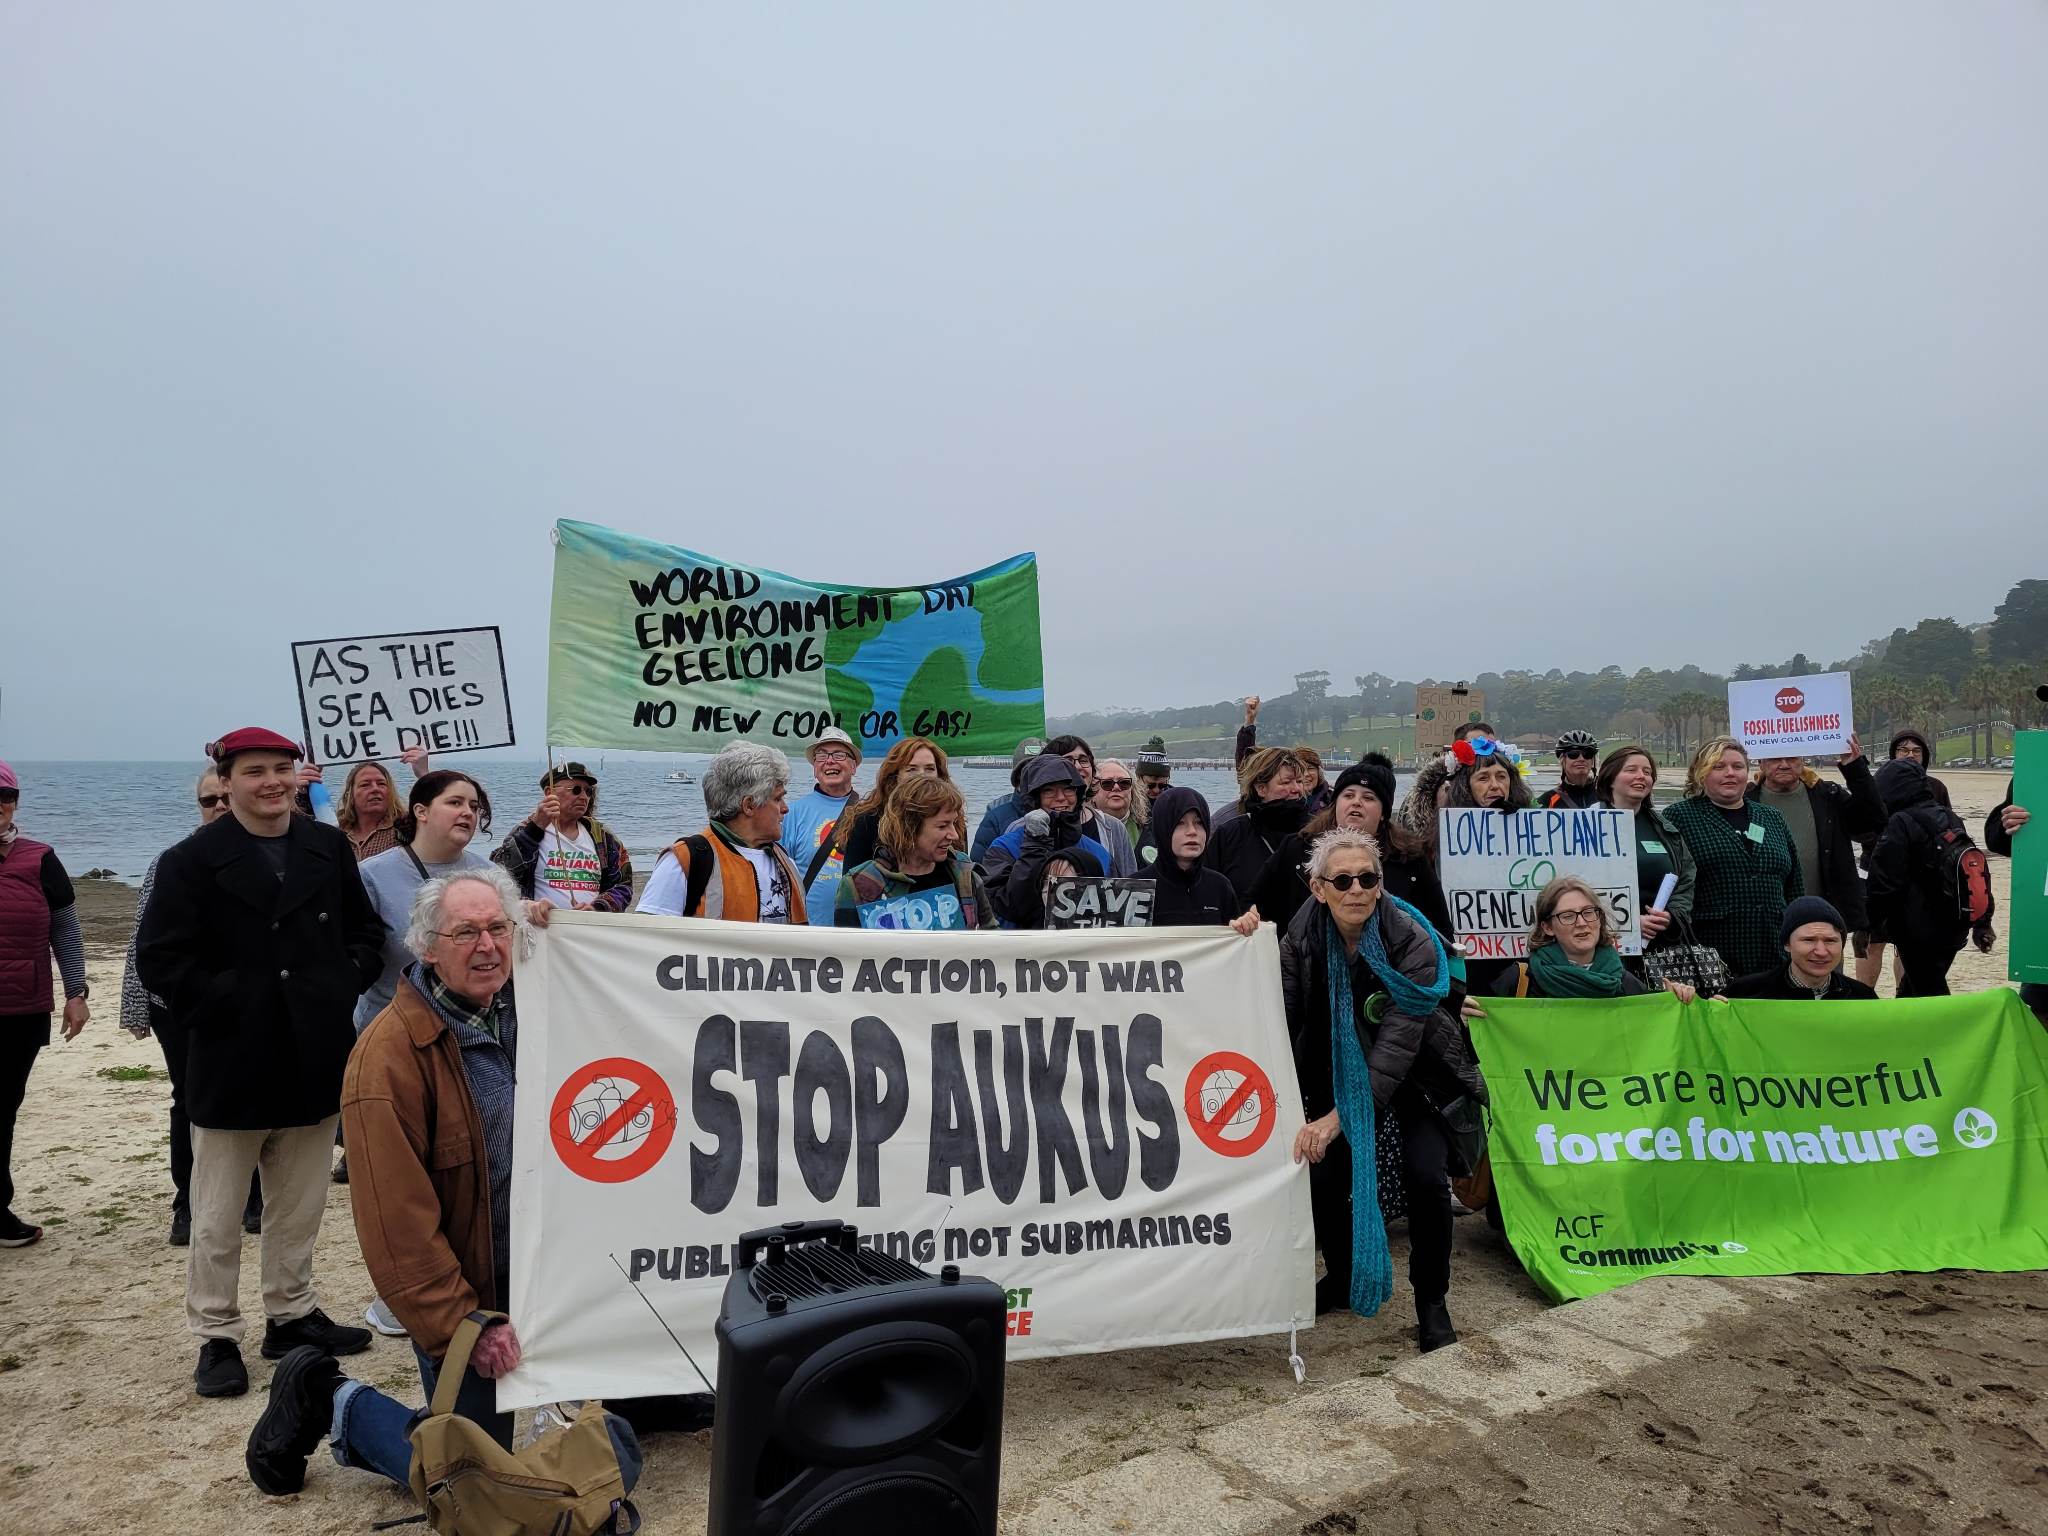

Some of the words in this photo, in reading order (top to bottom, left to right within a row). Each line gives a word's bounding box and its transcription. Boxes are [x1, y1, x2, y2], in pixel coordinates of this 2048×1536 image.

[629, 566, 761, 608] WORLD
[634, 593, 900, 650] ENVIRONMENT
[308, 645, 370, 688] AS
[379, 641, 456, 680] THE
[642, 637, 824, 687] GEELONG
[318, 691, 394, 728] SEA
[409, 682, 484, 715] DIES
[1420, 691, 1481, 707] SCIENCE
[1437, 709, 1464, 721] NOT
[1776, 695, 1804, 706] STOP
[323, 730, 381, 759] WE
[396, 719, 480, 752] DIE!!!
[633, 700, 677, 729] NO
[692, 705, 761, 734] NEW
[859, 710, 899, 739] OR
[912, 709, 972, 737] GAS!
[1420, 724, 1456, 737] SILE
[1743, 719, 1775, 736] FOSSIL
[1777, 714, 1841, 734] FUELISHNESS
[1759, 737, 1779, 745] NEW
[1807, 734, 1820, 742] OR
[1822, 733, 1842, 741] GAS
[1508, 858, 1557, 890] GO
[1051, 881, 1151, 927] SAVE
[1459, 935, 1508, 958] ONK
[1511, 936, 1526, 956] IF
[655, 954, 844, 993] CLIMATE
[1015, 958, 1090, 993] NOT
[1098, 960, 1185, 993] WAR
[1524, 1067, 1607, 1111] We
[1622, 1069, 1696, 1107] are
[1706, 1073, 1725, 1106] a
[1735, 1057, 1943, 1116] powerful
[689, 1014, 909, 1215] STOP
[926, 1013, 1181, 1205] AUKUS
[1535, 1123, 1682, 1166] force
[1688, 1117, 1755, 1163] for
[1763, 1123, 1939, 1165] nature
[1554, 1214, 1605, 1239] ACF
[629, 1246, 760, 1282] PUBLI
[944, 1219, 1019, 1262] NOT
